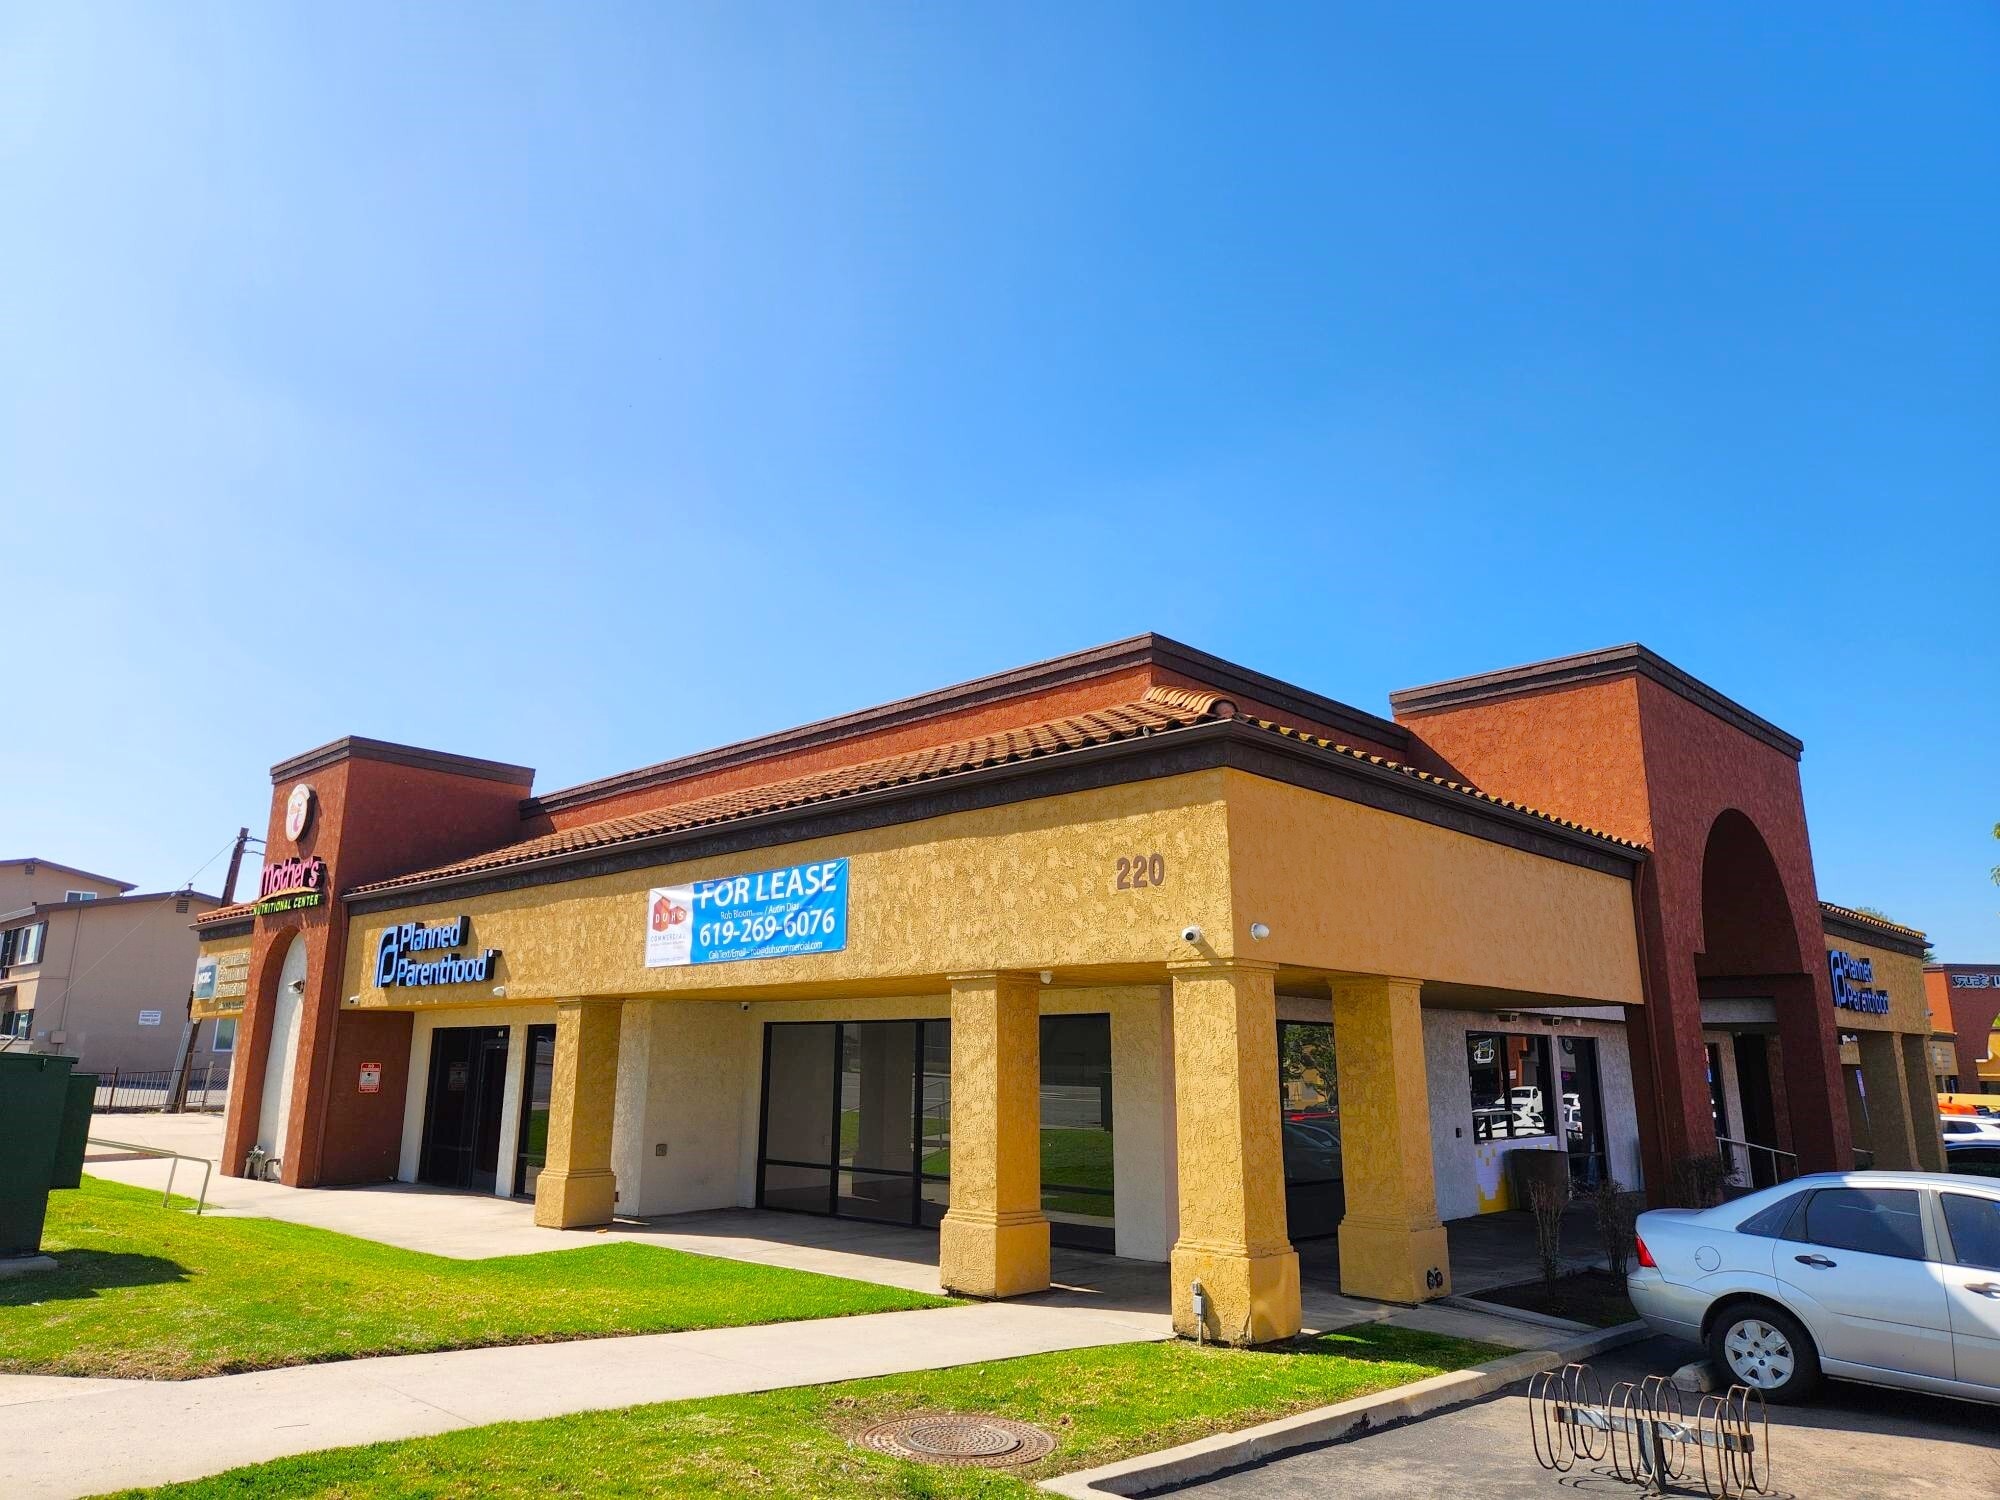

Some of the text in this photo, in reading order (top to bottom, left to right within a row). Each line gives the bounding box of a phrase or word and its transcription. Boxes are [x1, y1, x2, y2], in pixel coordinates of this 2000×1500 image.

[260, 857, 320, 896] Mother's
[700, 862, 837, 909] FOR LEASE
[1116, 853, 1165, 890] 220
[253, 894, 320, 916] NUTRITIONAL CENTER
[655, 911, 684, 924] DUHS
[720, 910, 732, 920] Rob
[733, 908, 752, 919] Bloom
[400, 916, 463, 951] Planned
[700, 907, 836, 946] 619-269-6076
[397, 949, 489, 986] Parenthood
[1842, 952, 1873, 982] Planned
